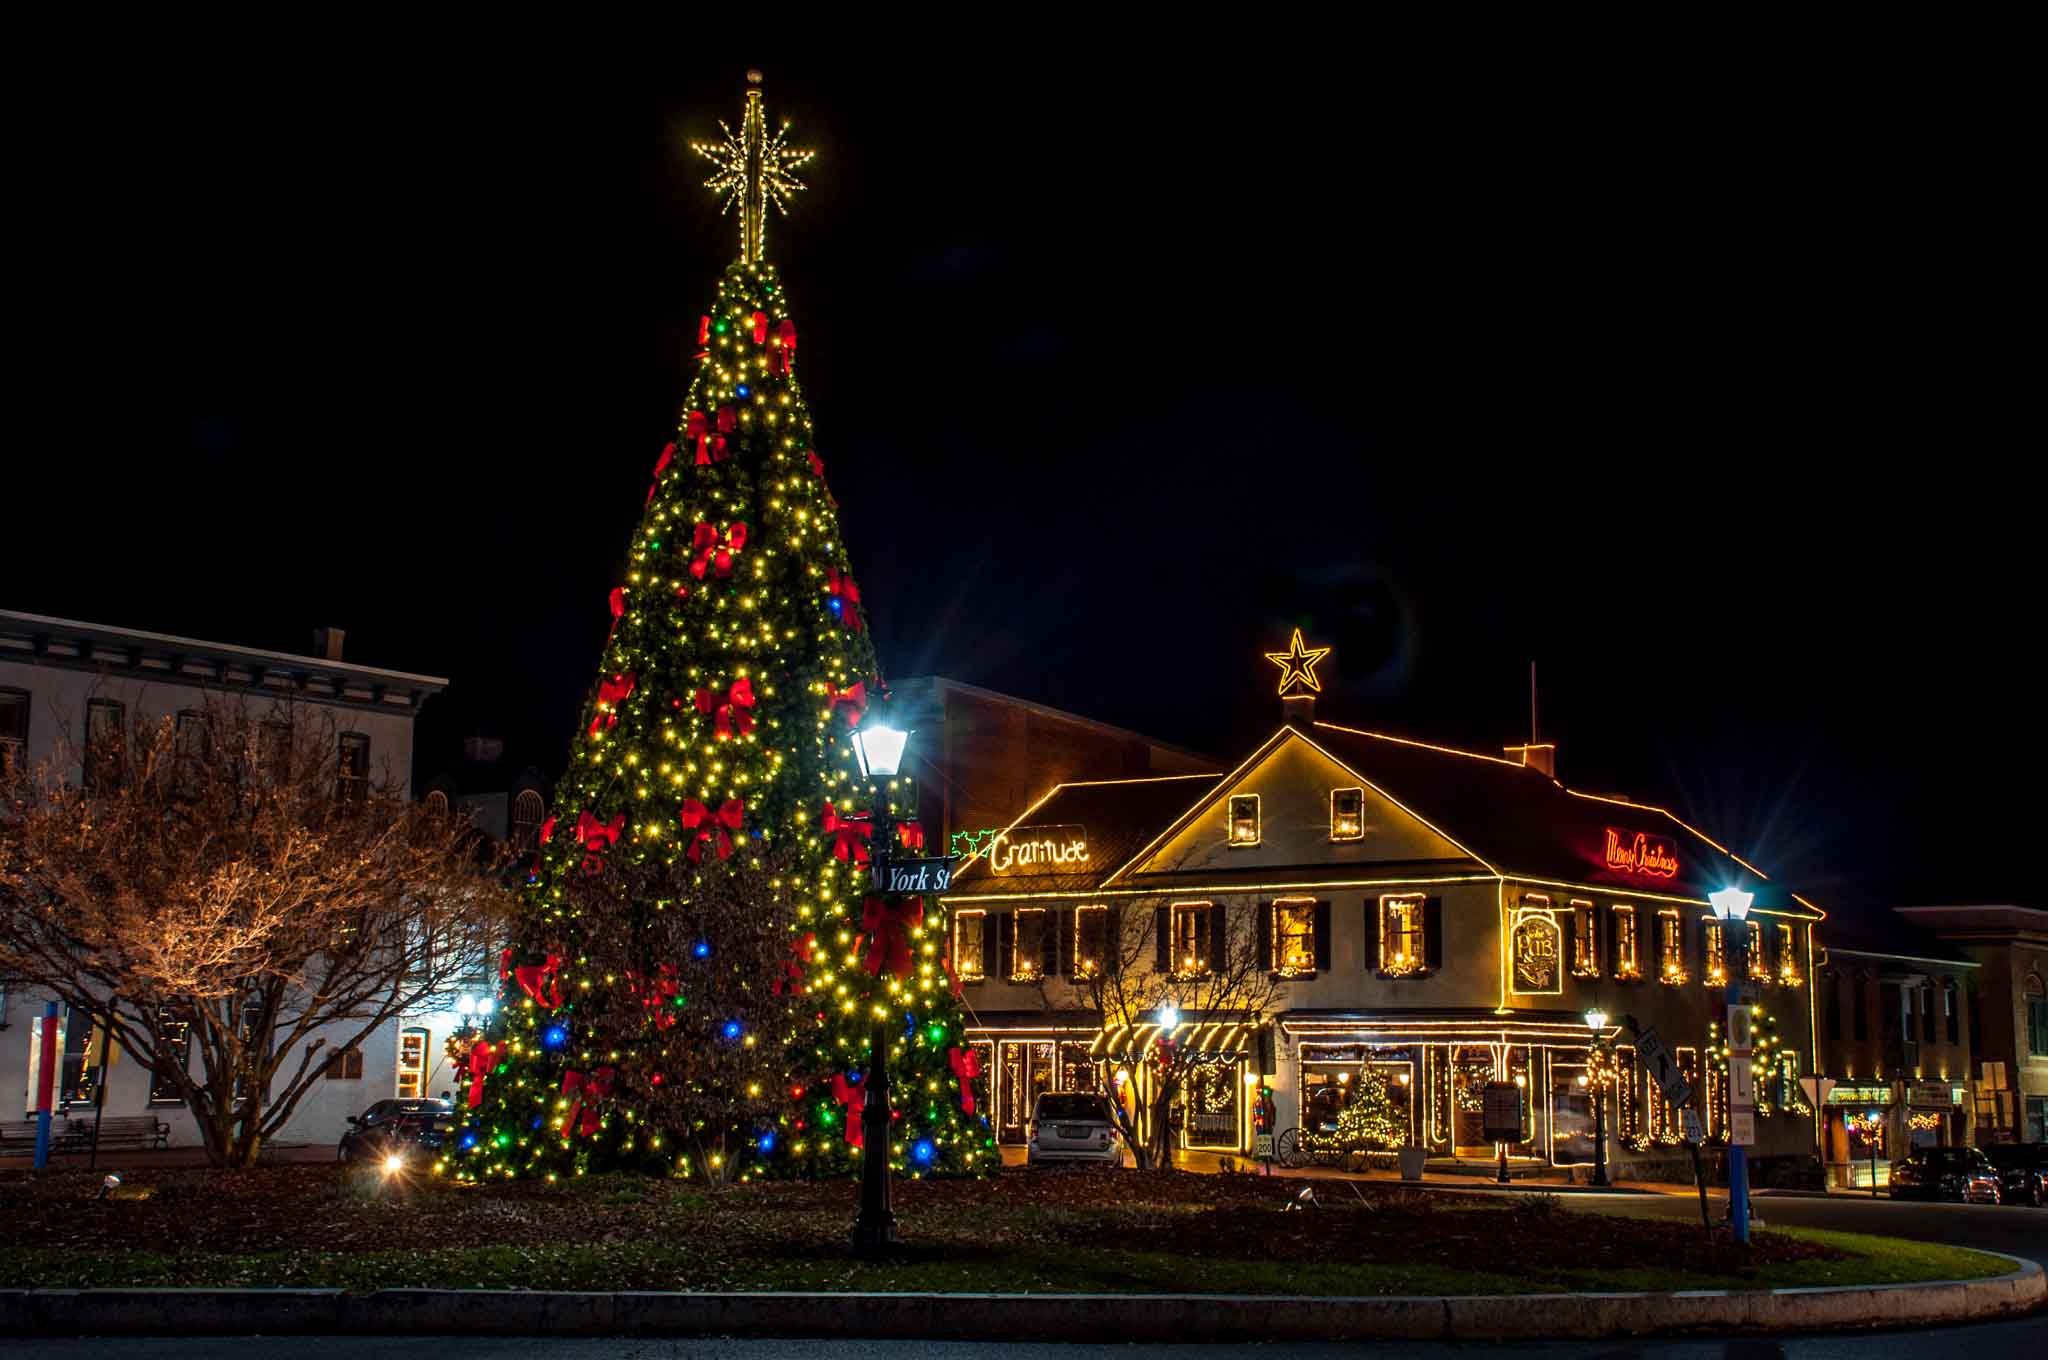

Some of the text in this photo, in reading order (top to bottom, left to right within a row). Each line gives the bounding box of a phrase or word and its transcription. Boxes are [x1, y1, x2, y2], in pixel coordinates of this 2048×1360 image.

[991, 835, 1090, 870] Gratitude
[1606, 830, 1678, 877] Merry Christmas
[888, 866, 930, 891] York
[933, 868, 950, 890] St
